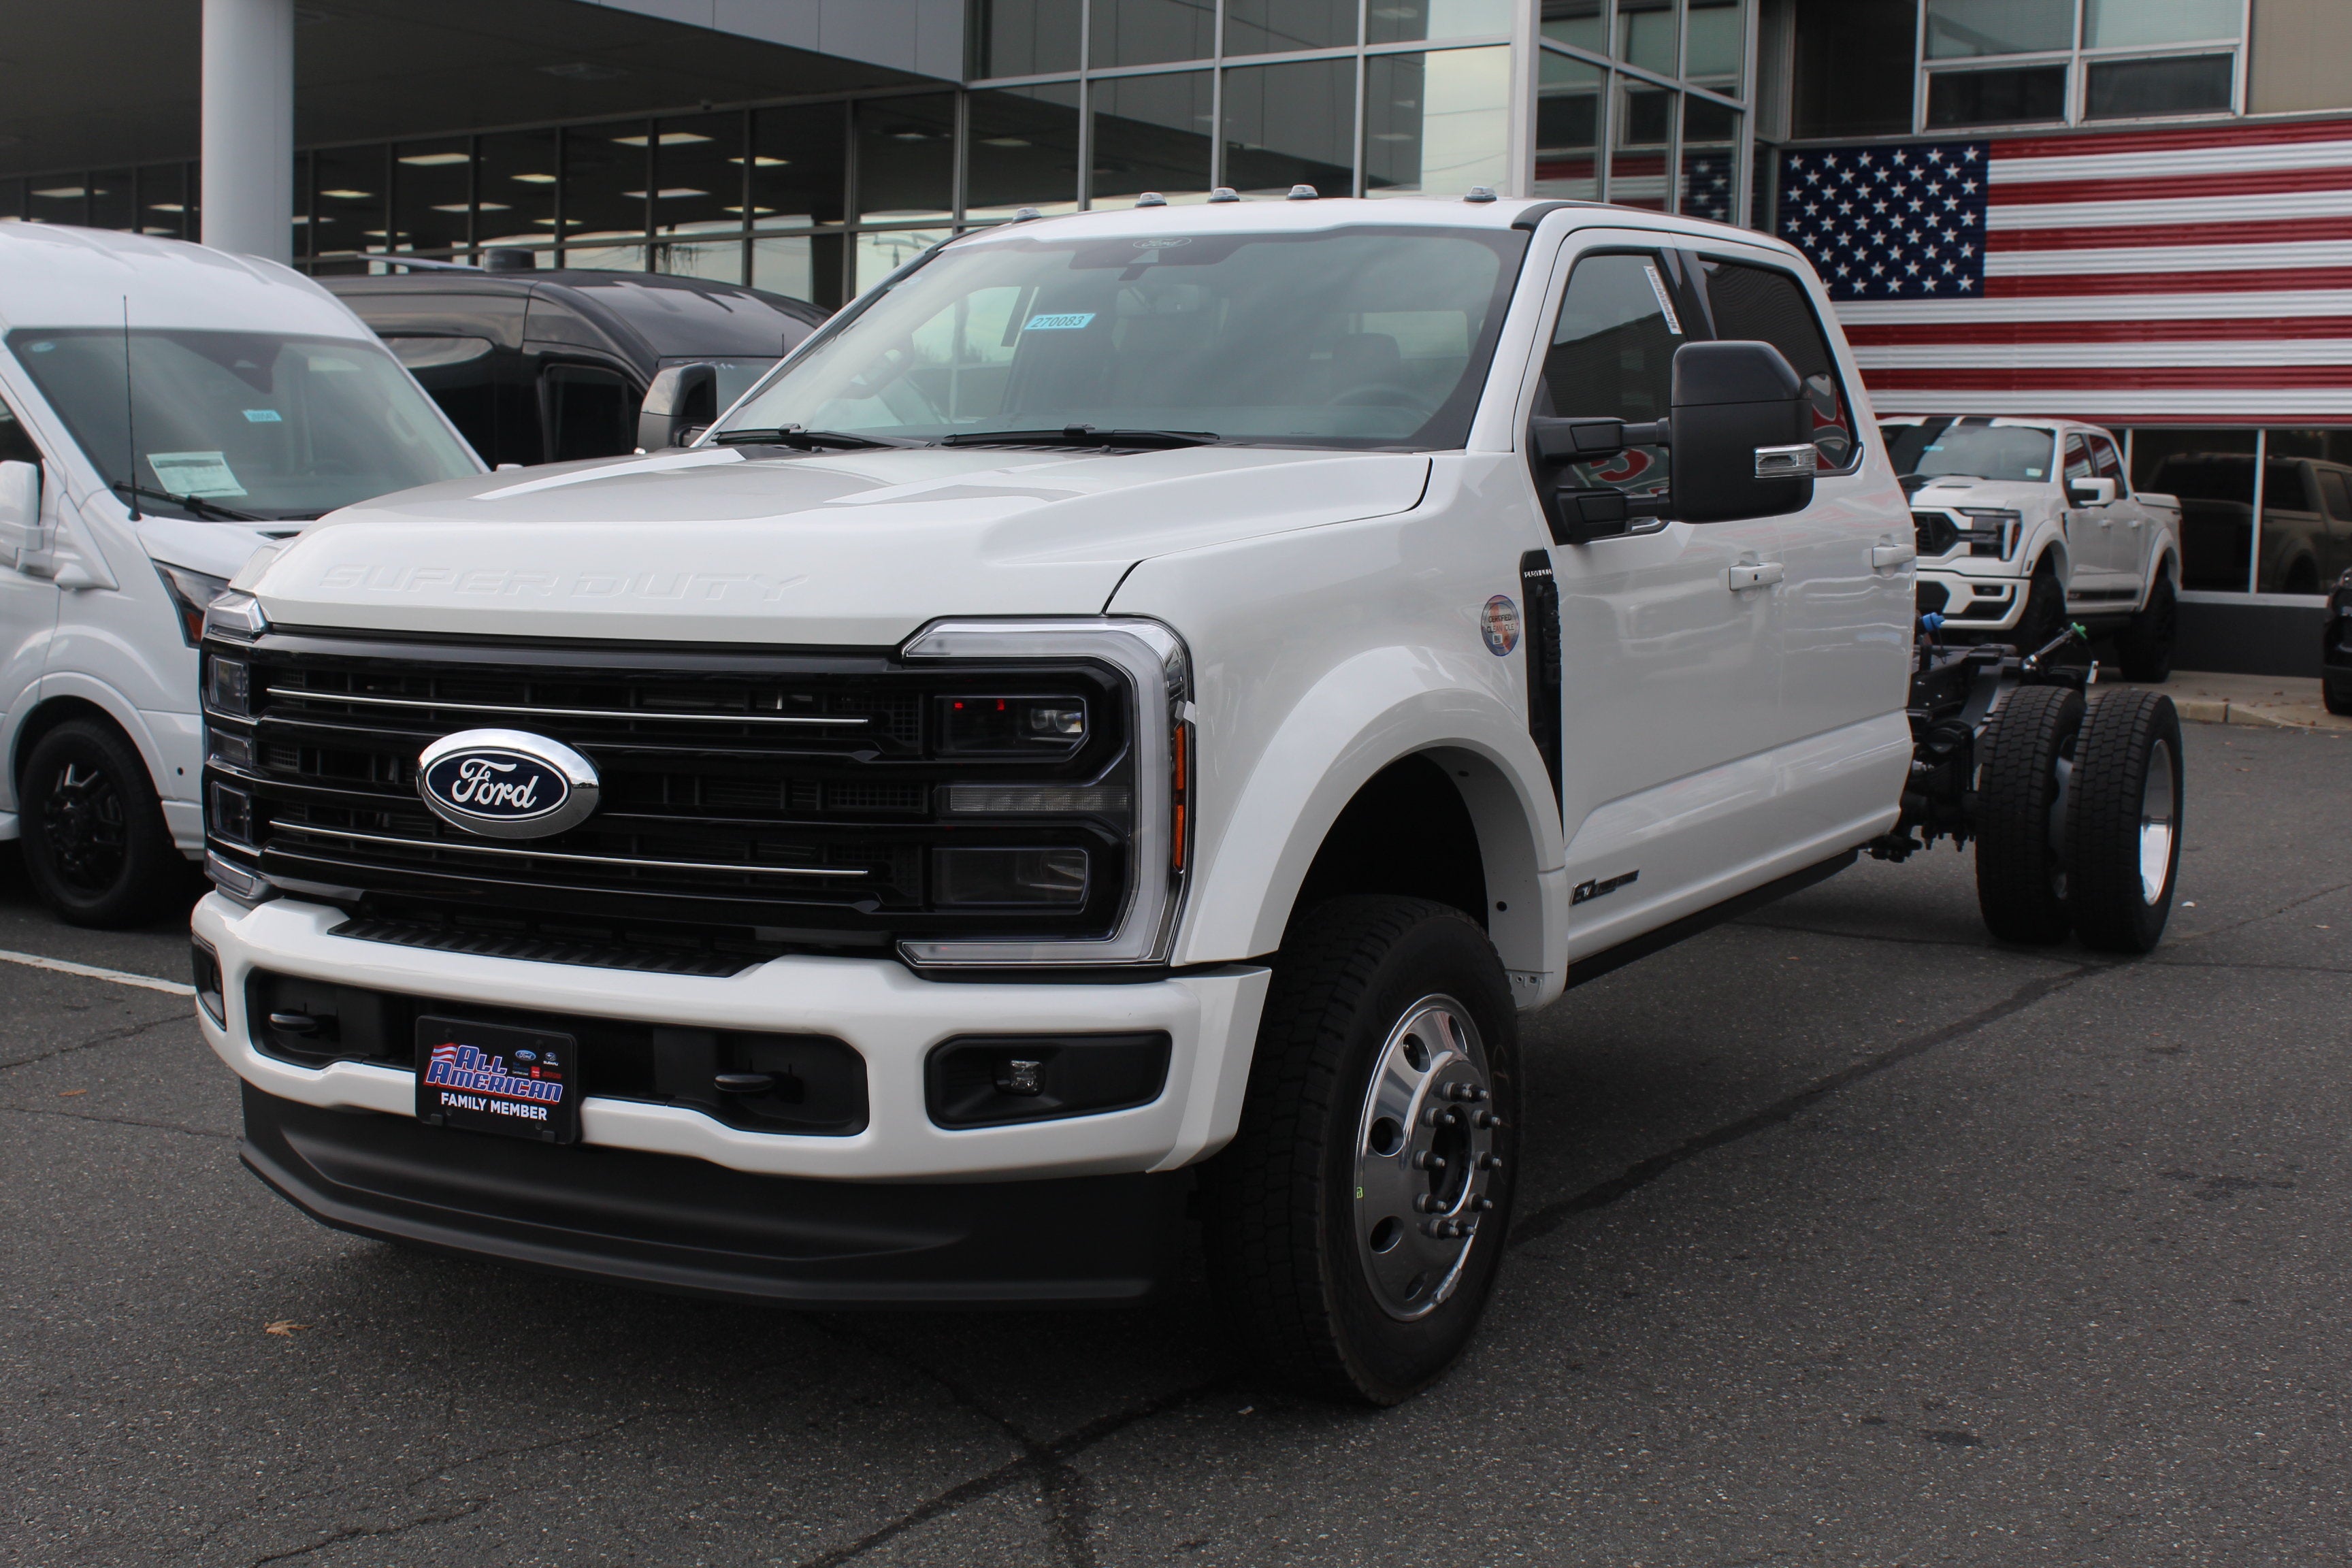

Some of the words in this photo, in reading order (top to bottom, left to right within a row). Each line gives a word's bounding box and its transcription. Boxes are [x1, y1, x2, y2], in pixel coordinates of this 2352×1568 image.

[1141, 239, 1183, 247] Ford
[1030, 315, 1085, 328] 270083
[319, 563, 559, 596] SUPER
[570, 570, 811, 602] DUTY
[1488, 614, 1512, 623] CERTIFIED
[451, 757, 540, 809] Ford
[455, 1044, 508, 1075] ALL
[519, 1051, 532, 1060] Ford
[425, 1060, 564, 1104] AMERICAN
[440, 1092, 487, 1111] FAMILY
[490, 1099, 548, 1121] MEMBER
